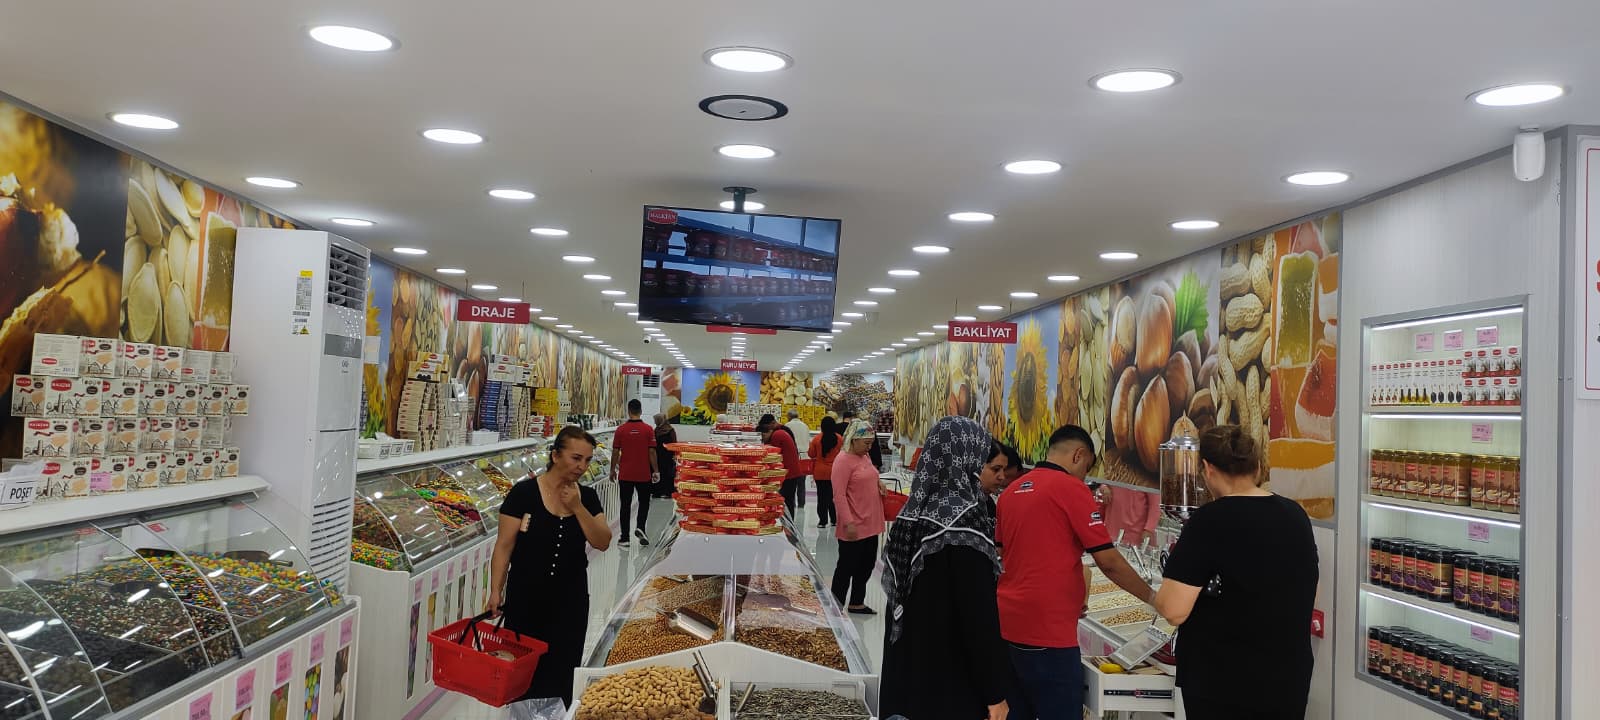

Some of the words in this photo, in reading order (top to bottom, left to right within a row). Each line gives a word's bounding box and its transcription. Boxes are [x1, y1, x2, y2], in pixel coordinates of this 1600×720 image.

[471, 305, 515, 318] DRAJE
[953, 325, 1012, 339] BAKLİYAT
[10, 487, 33, 502] POŞET
